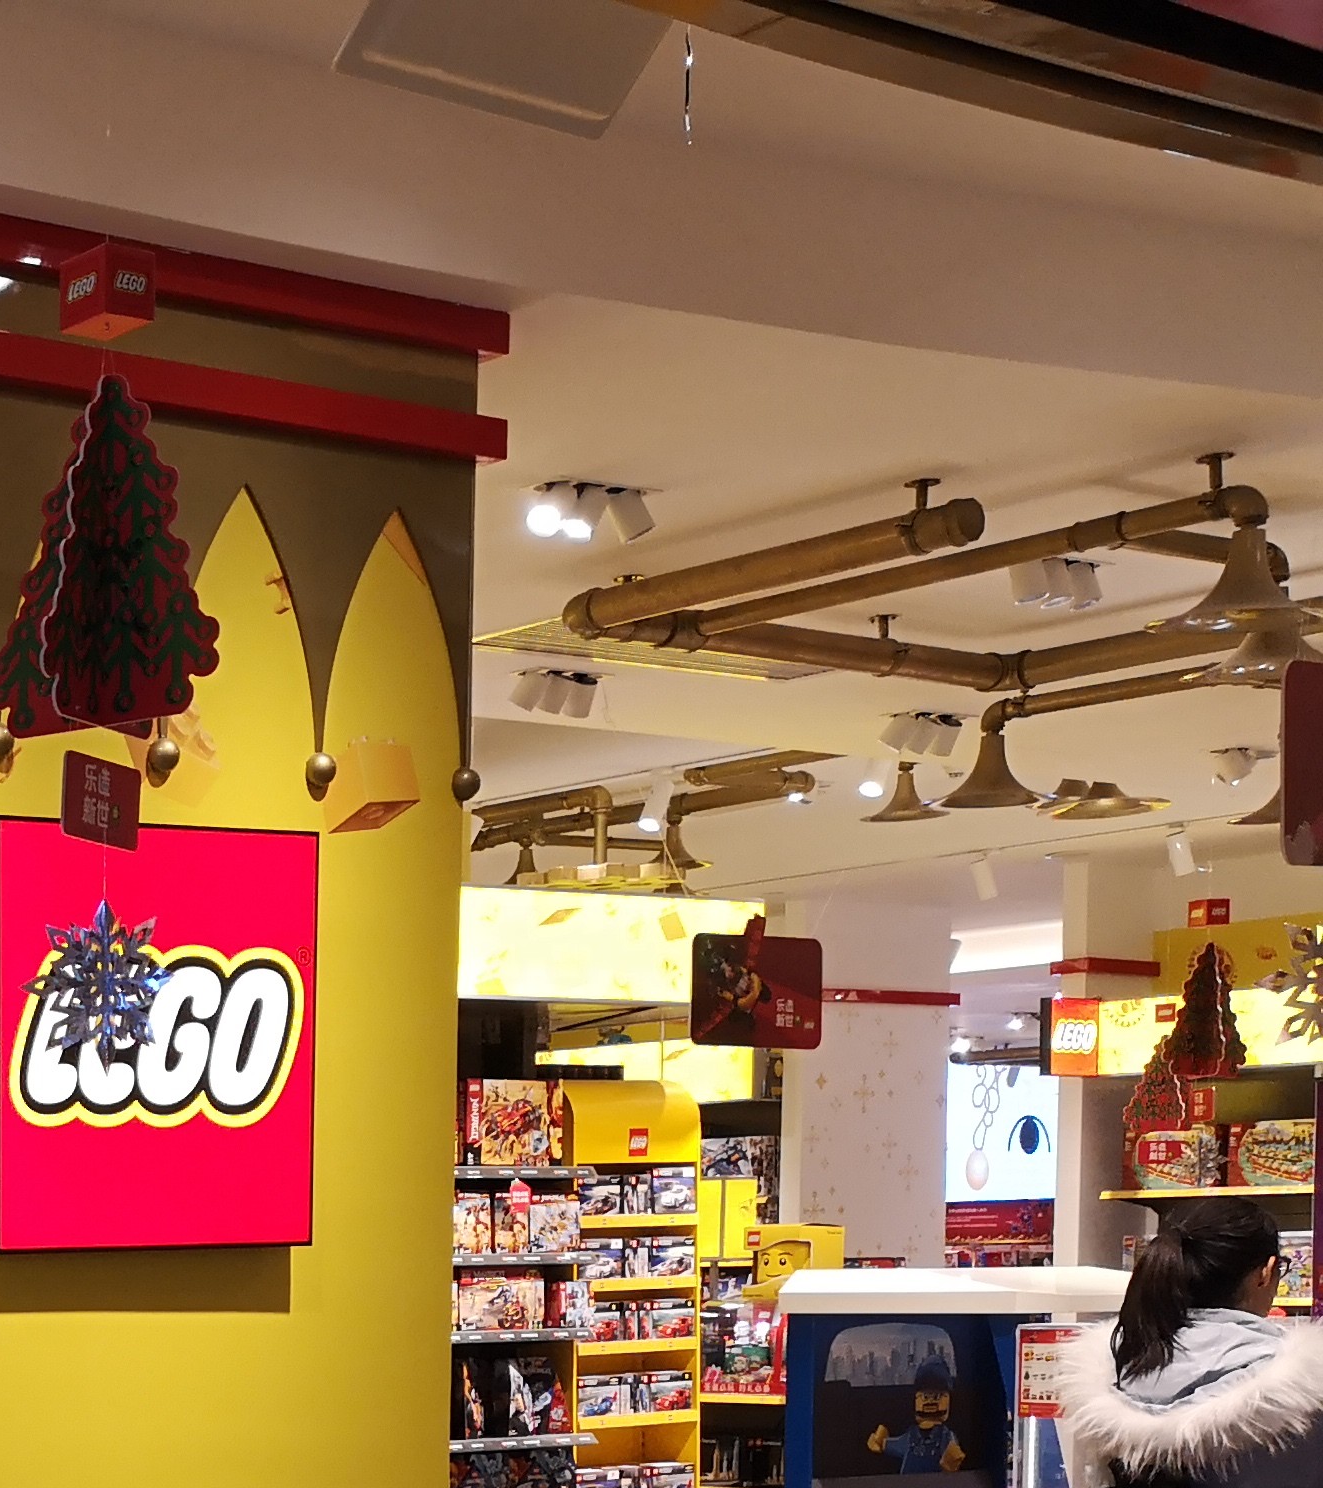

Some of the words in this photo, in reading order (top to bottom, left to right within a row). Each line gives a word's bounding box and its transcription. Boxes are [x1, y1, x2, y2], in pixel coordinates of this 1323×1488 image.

[68, 272, 96, 303] LEGO
[115, 271, 147, 294] LEGO
[1053, 1020, 1097, 1053] LEGO
